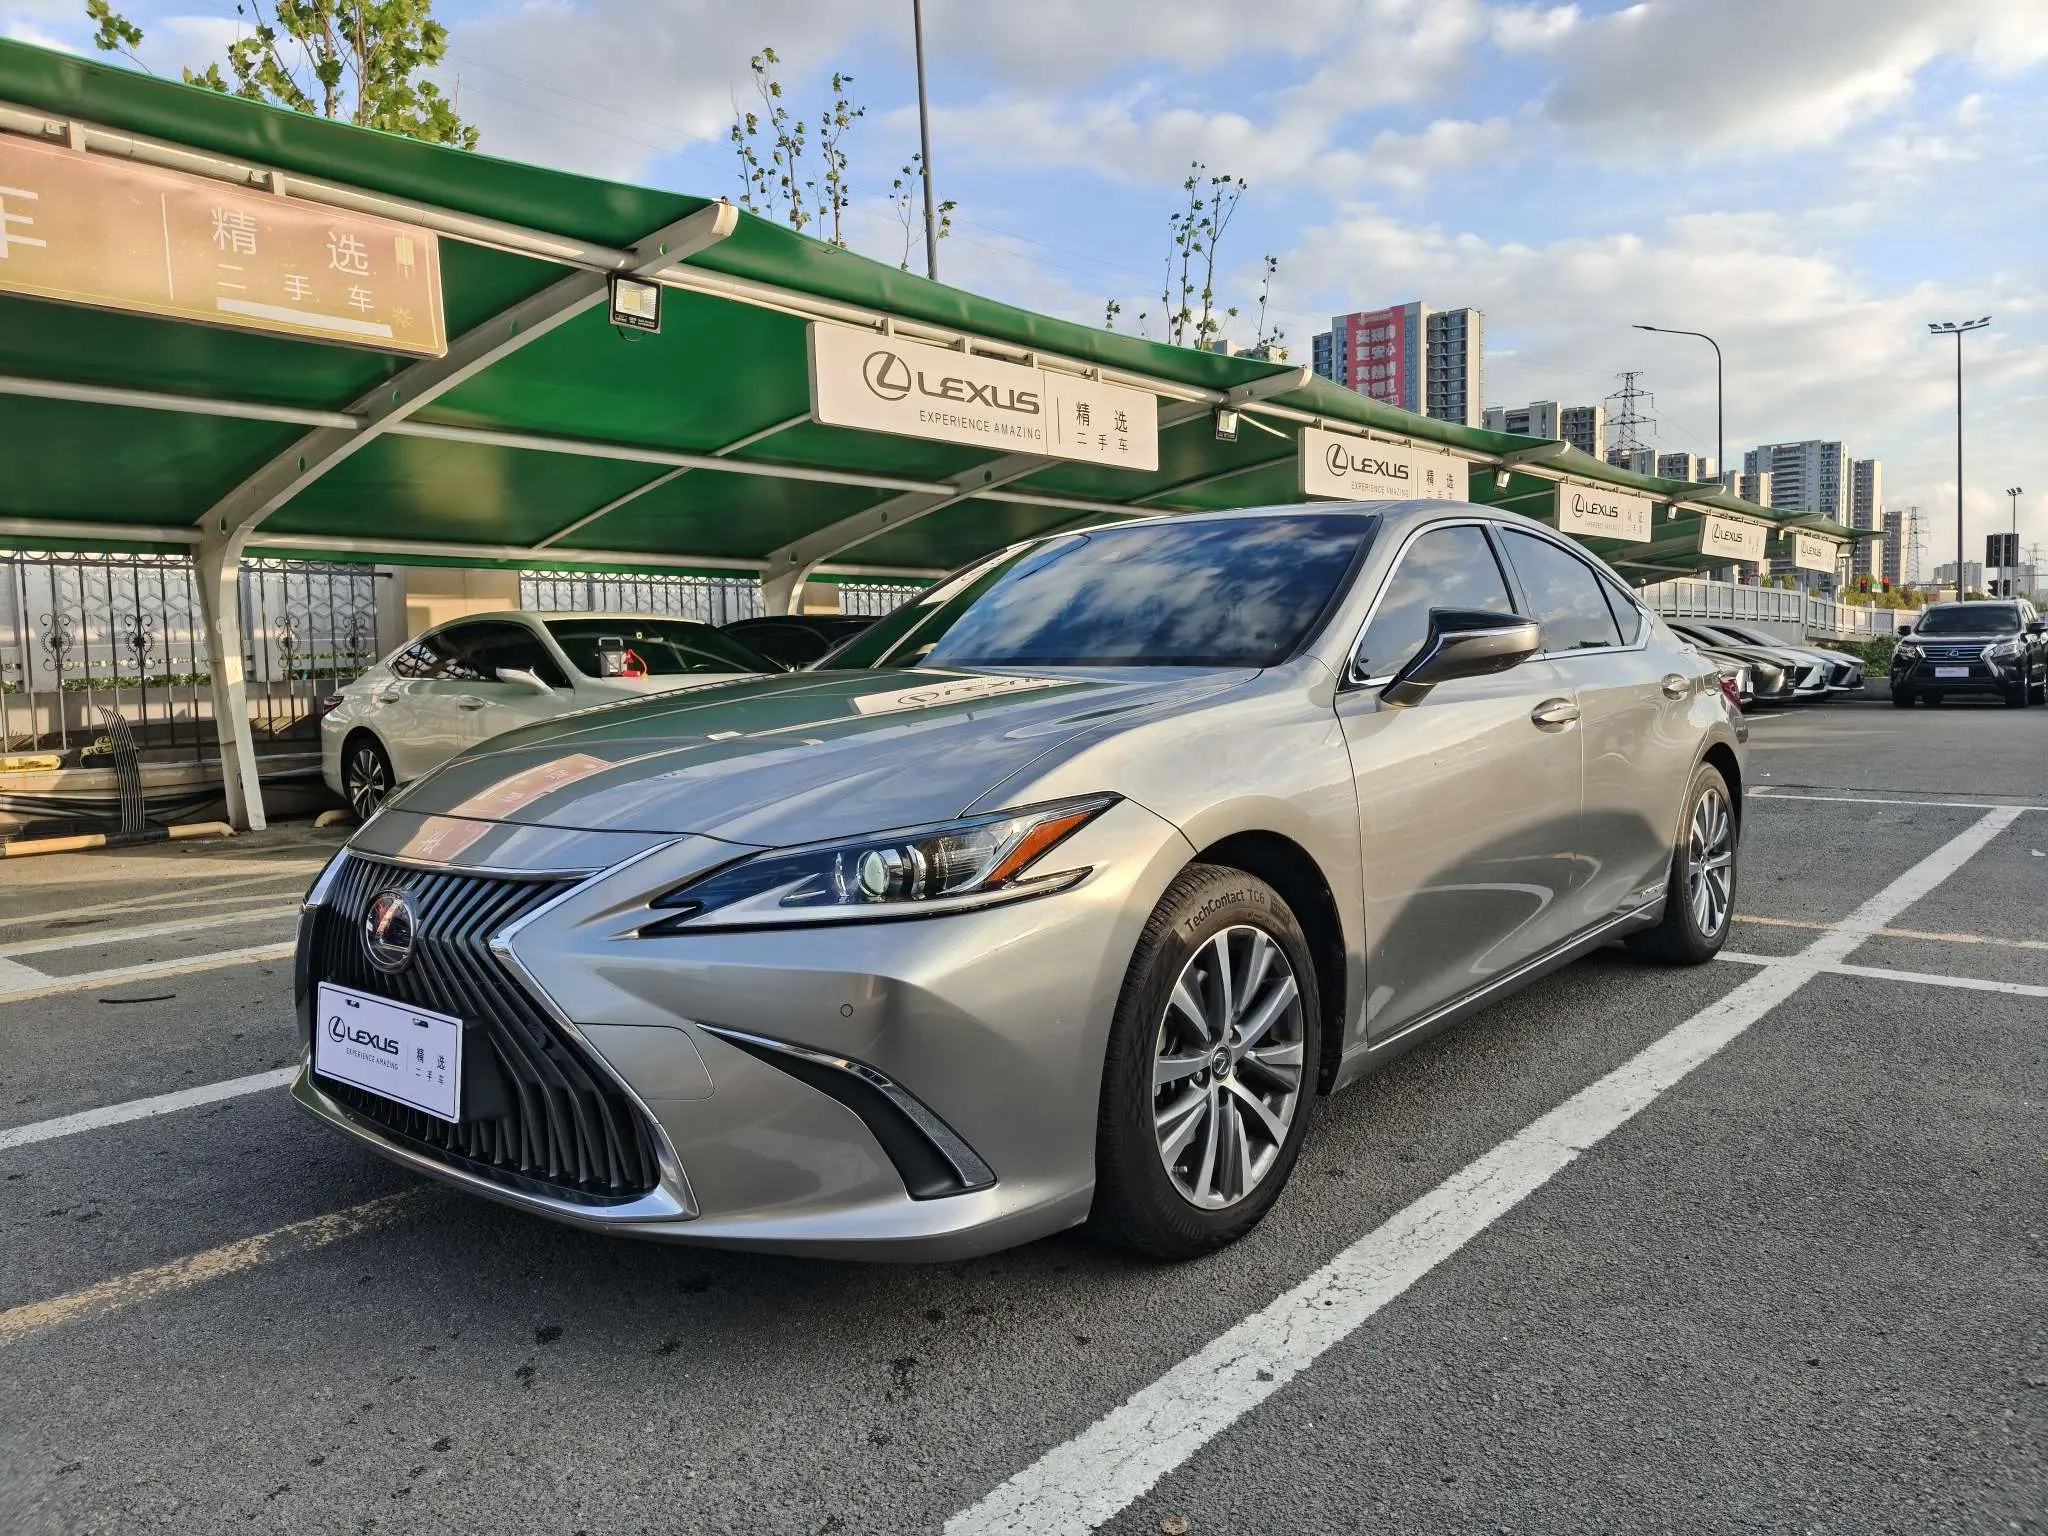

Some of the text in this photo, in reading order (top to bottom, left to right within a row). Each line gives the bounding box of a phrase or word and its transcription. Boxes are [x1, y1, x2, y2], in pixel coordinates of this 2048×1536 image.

[210, 206, 370, 277] 精选
[217, 262, 375, 313] 二手车
[918, 371, 1040, 415] LEXUS
[919, 410, 1041, 440] EXPERIENCE AMAZING
[1075, 401, 1129, 434] 精选
[1076, 431, 1129, 454] 二手车
[1351, 455, 1409, 480] LEXUS
[1351, 480, 1409, 498] EXPERIENCE AMAZING
[1585, 501, 1618, 518] LEXUS
[1720, 530, 1743, 543] LEXUS
[1807, 545, 1822, 557] LEXUS
[1184, 889, 1246, 932] TechContact
[1247, 889, 1265, 905] TC6
[347, 1026, 399, 1055] LEXUS
[346, 1047, 399, 1071] EXPERIENCE AMAZING
